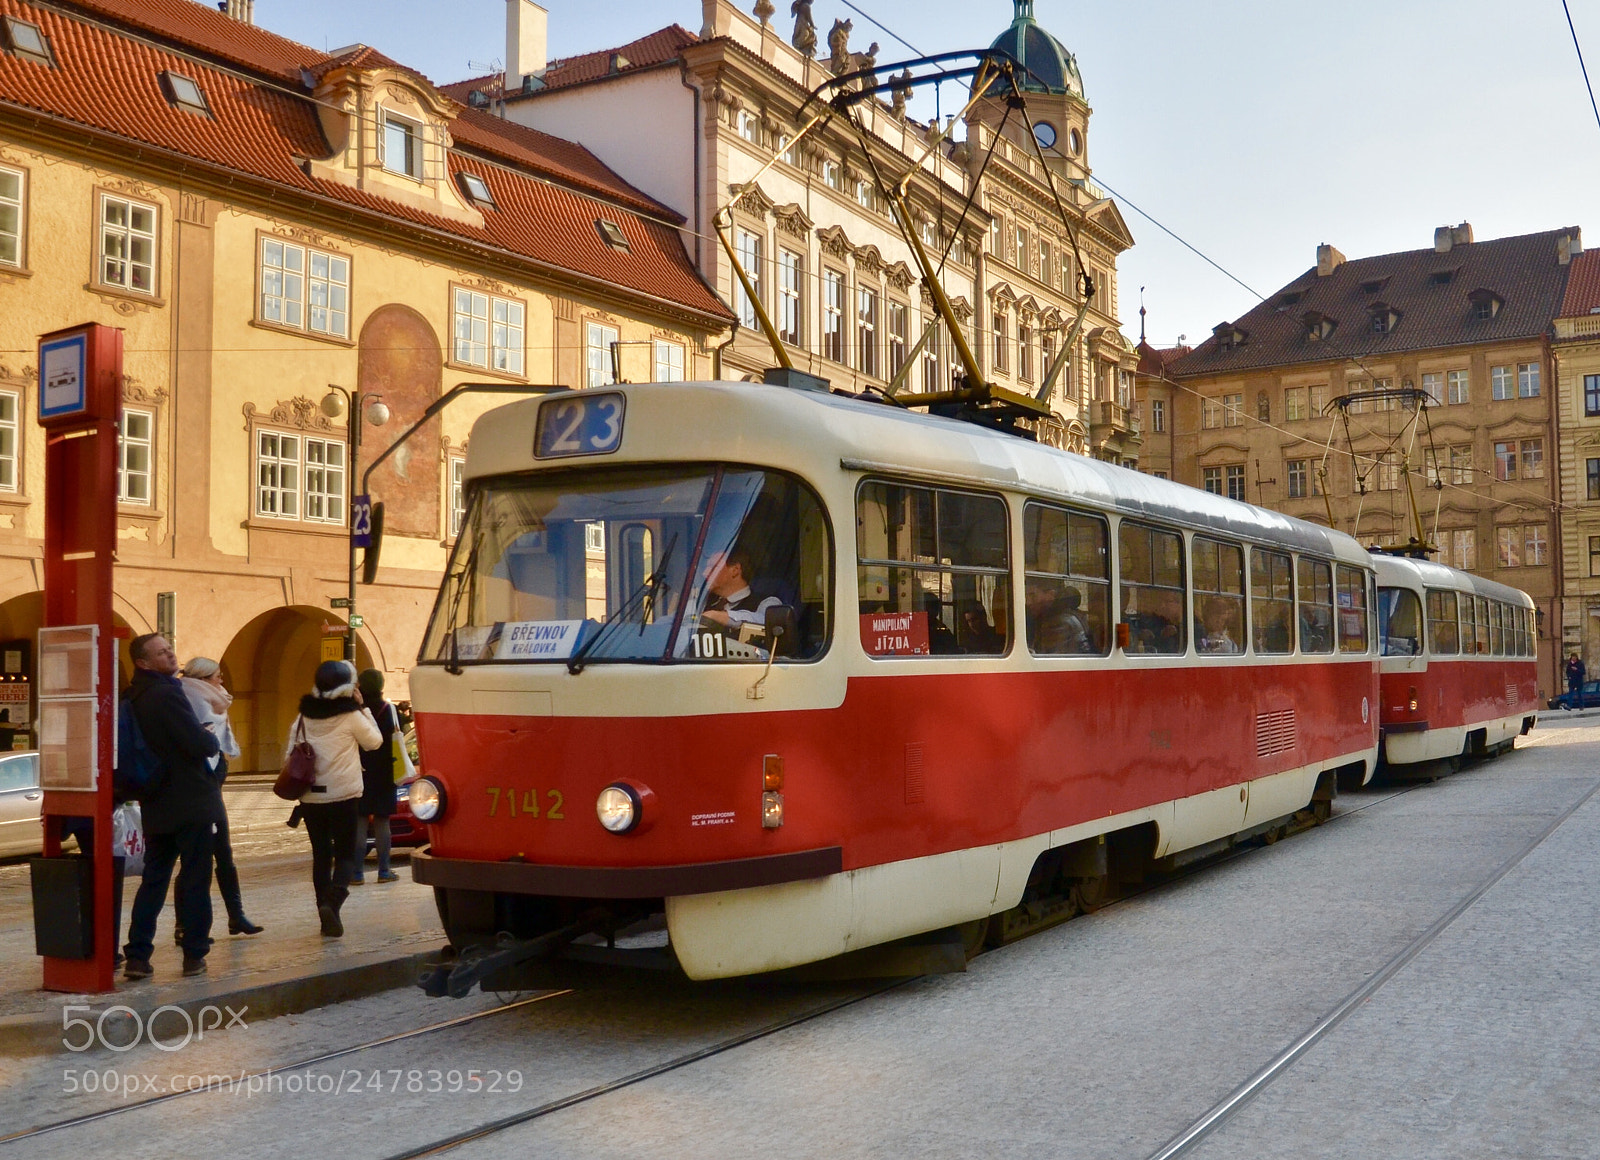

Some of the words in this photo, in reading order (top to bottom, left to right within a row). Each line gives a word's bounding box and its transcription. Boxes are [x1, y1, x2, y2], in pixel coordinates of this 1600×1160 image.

[550, 398, 622, 451] 23
[354, 503, 371, 535] 23
[511, 624, 569, 641] BŘEVNOV
[691, 632, 723, 658] 101
[874, 635, 910, 651] JÍZDA
[486, 787, 564, 819] 7142
